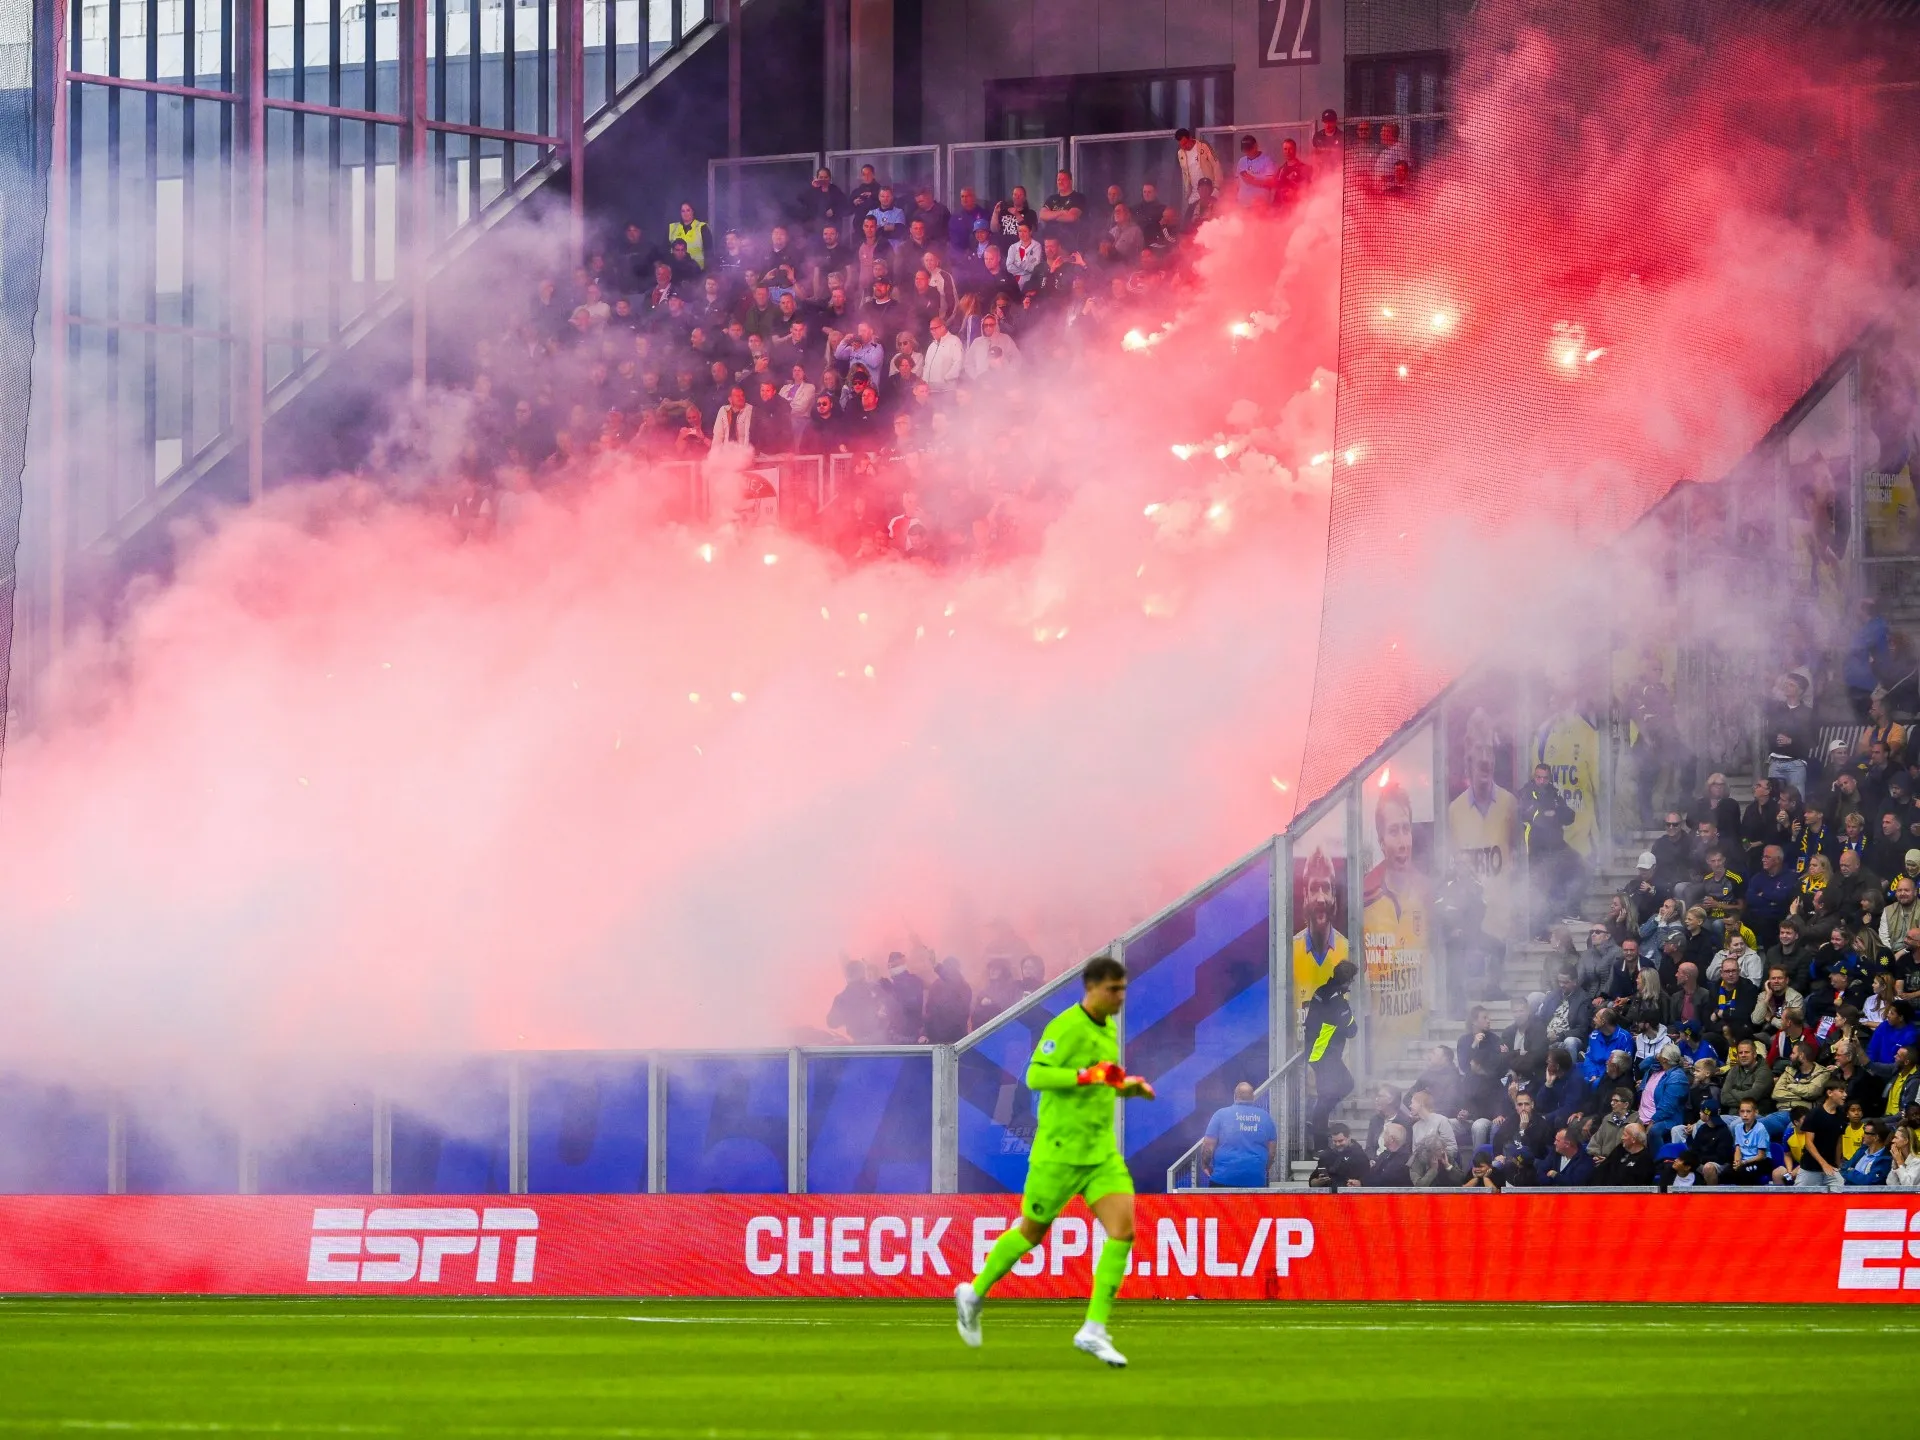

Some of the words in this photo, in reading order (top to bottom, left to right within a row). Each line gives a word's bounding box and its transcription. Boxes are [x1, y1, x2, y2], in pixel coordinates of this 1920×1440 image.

[1267, 0, 1312, 60] 22
[1236, 1111, 1260, 1122] Security
[306, 1208, 539, 1282] ESPN
[745, 1216, 952, 1275] CHECK
[1837, 1209, 1920, 1290] E
